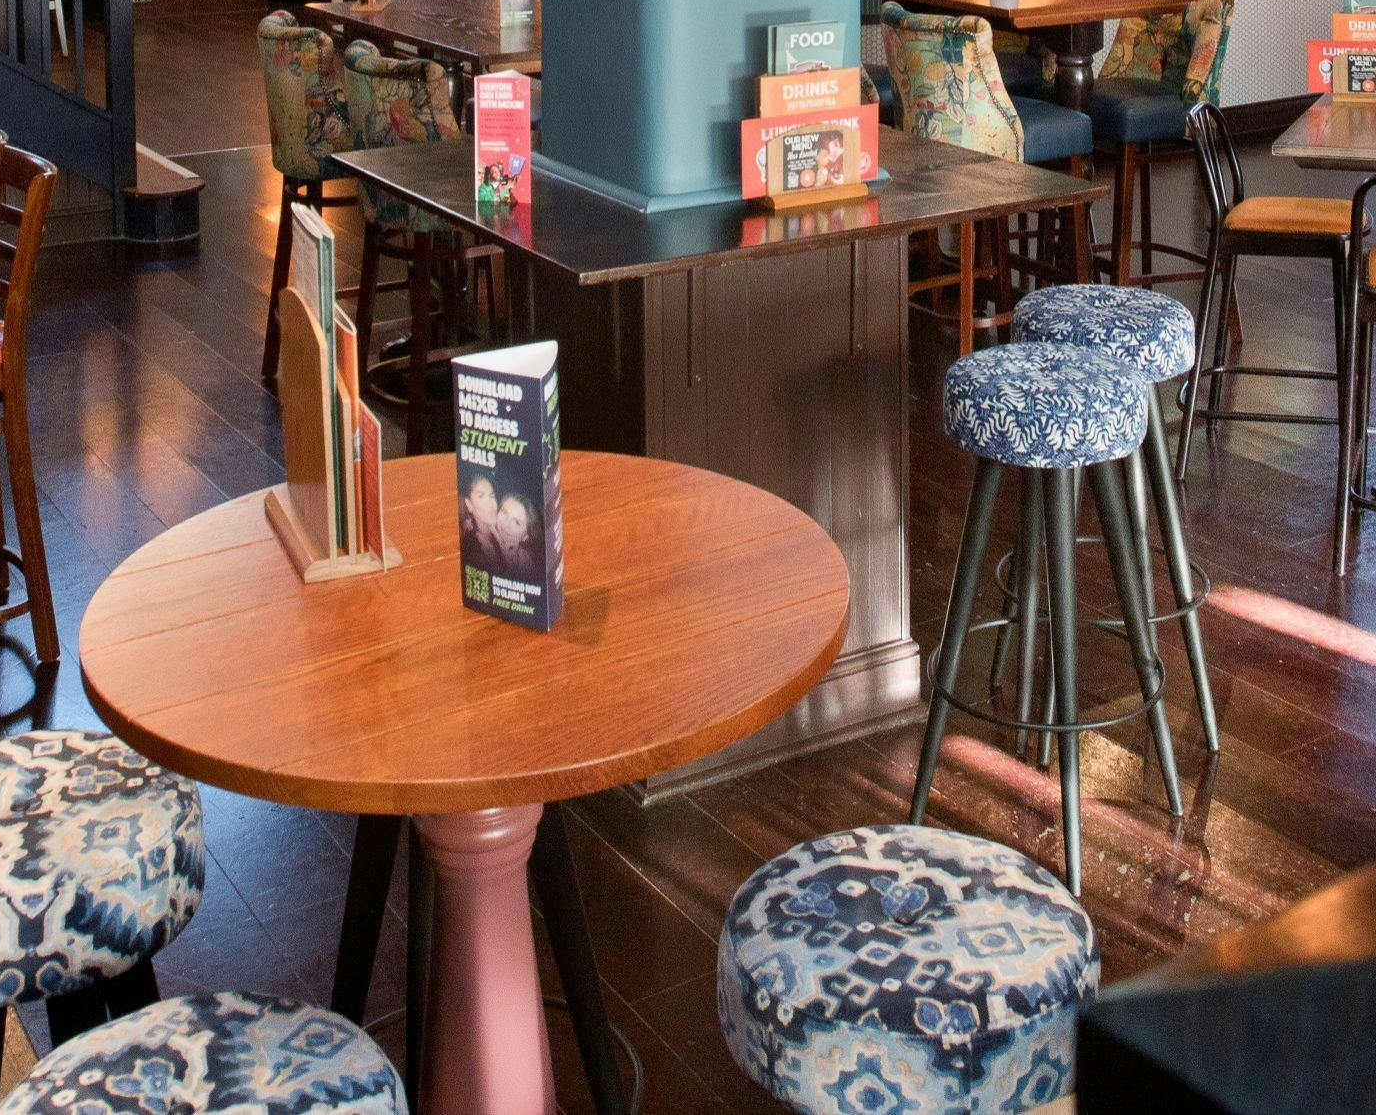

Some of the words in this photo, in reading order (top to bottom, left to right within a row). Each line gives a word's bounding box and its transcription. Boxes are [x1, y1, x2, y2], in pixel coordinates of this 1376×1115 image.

[790, 31, 834, 48] FOOD
[782, 80, 839, 100] DRINKS
[761, 124, 805, 141] LUN
[822, 116, 859, 129] INK
[784, 136, 800, 146] OUR
[801, 134, 819, 143] NEW
[792, 143, 813, 151] MENU
[458, 374, 523, 402] DOWNLOAD
[459, 409, 473, 427] TO
[474, 413, 519, 438] ACCESS
[460, 428, 528, 456] STUDENT
[461, 444, 496, 468] DEALS
[493, 597, 510, 609] FREE
[511, 602, 535, 615] DRINK
